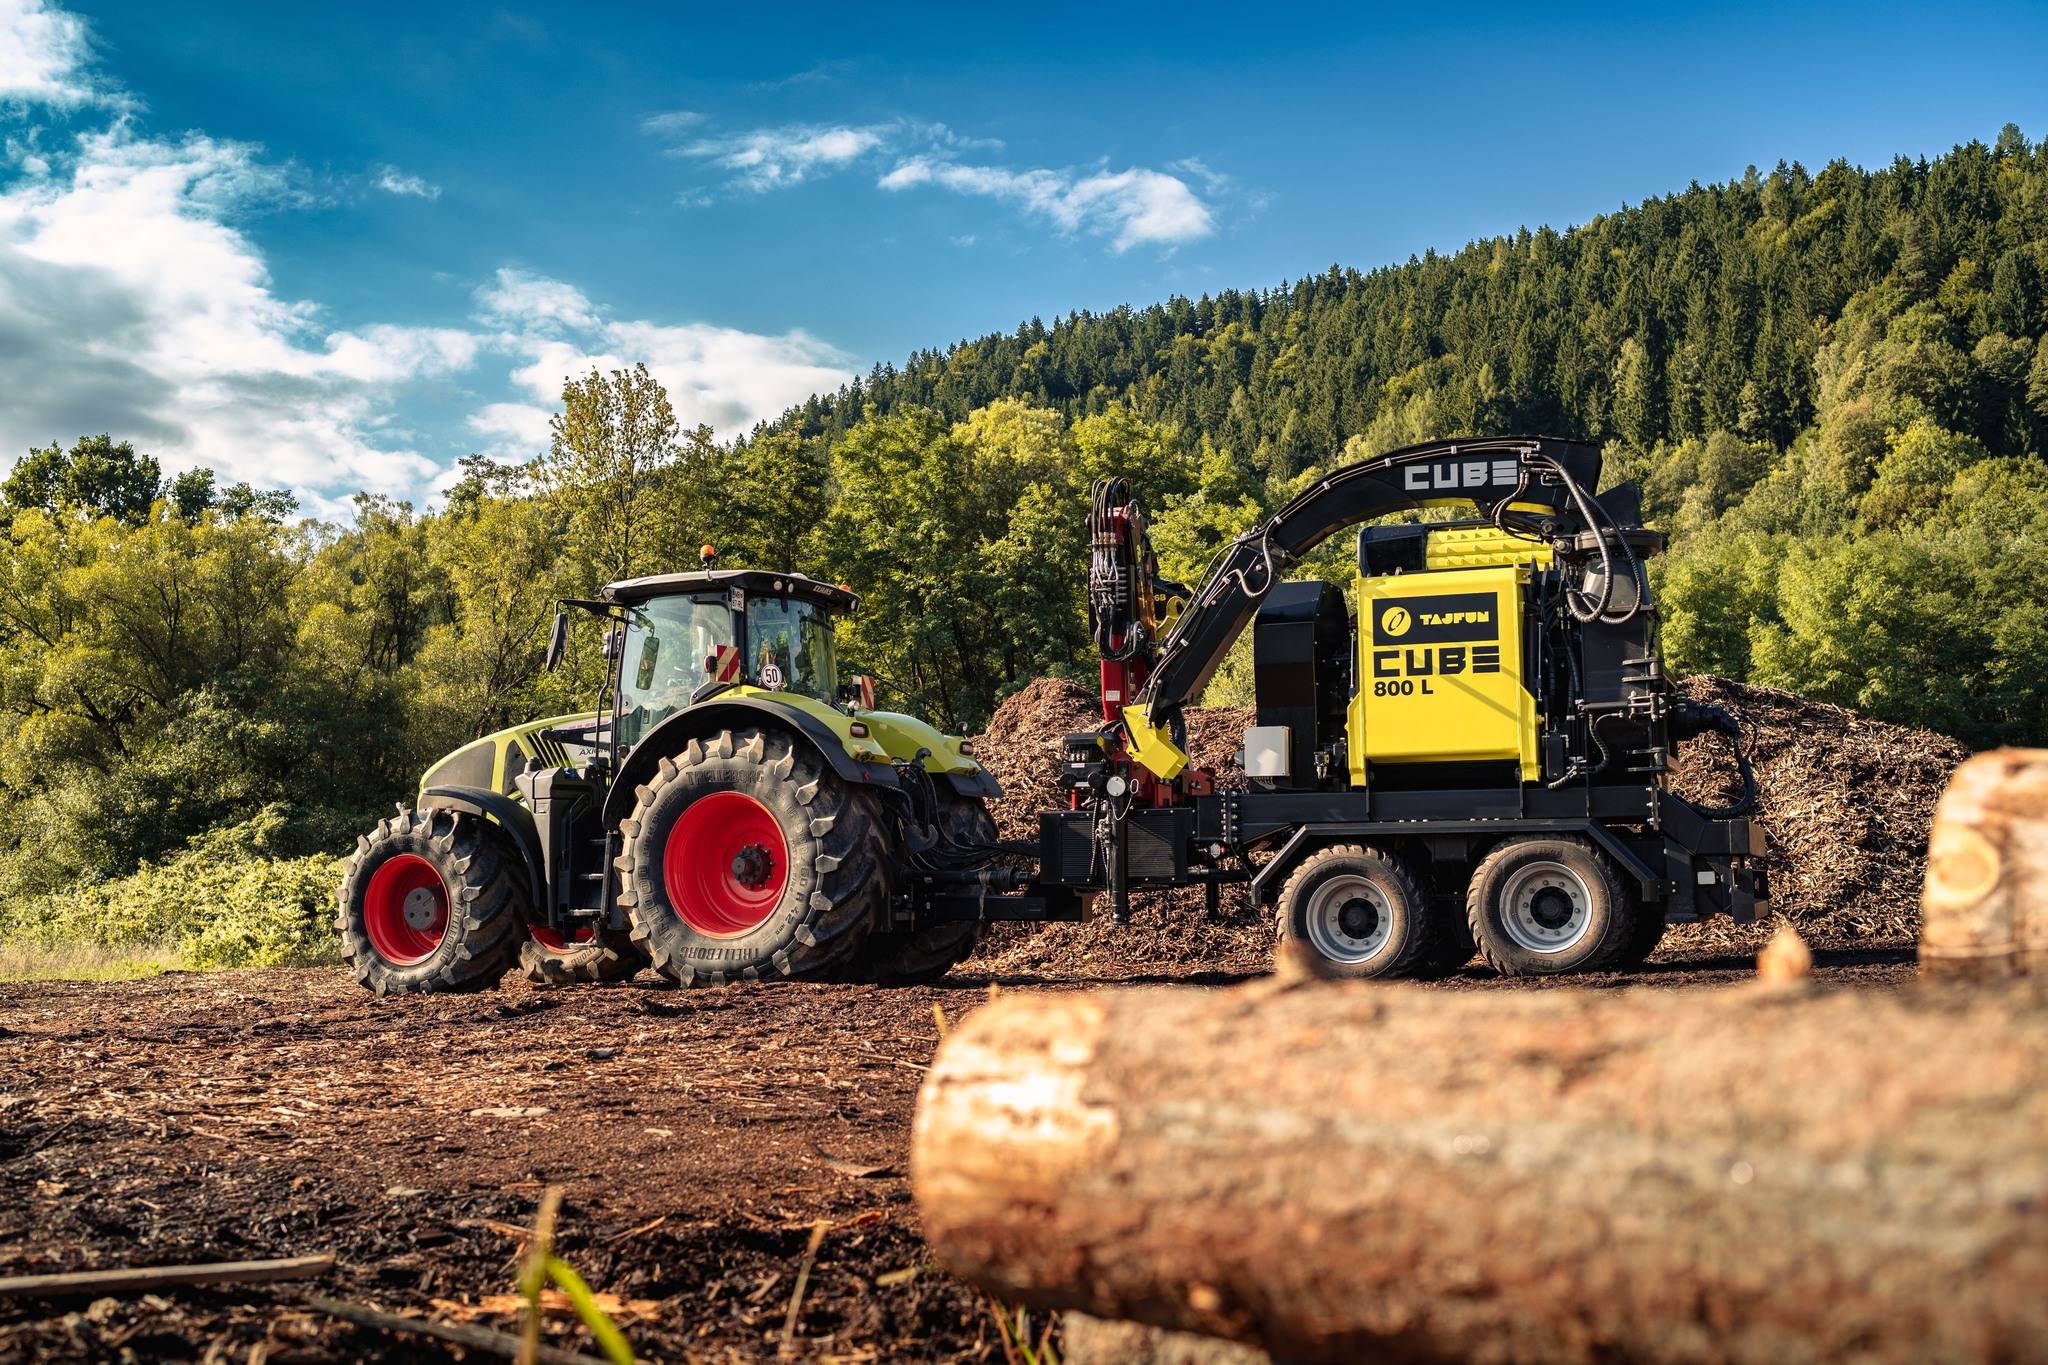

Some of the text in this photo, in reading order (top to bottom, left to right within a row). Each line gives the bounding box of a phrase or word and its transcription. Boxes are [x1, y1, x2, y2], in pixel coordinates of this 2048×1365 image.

[1405, 460, 1518, 490] CUBE
[813, 585, 833, 596] CLAAS
[1420, 611, 1489, 625] TAJFUN
[1373, 646, 1500, 678] CUBE
[765, 668, 778, 684] 50
[1374, 679, 1434, 697] 800 L
[686, 768, 765, 786] TRELLEBORG
[638, 864, 676, 947] TM1000
[439, 901, 463, 963] TRELLEBORG
[680, 947, 763, 961] TRELLEBORG
